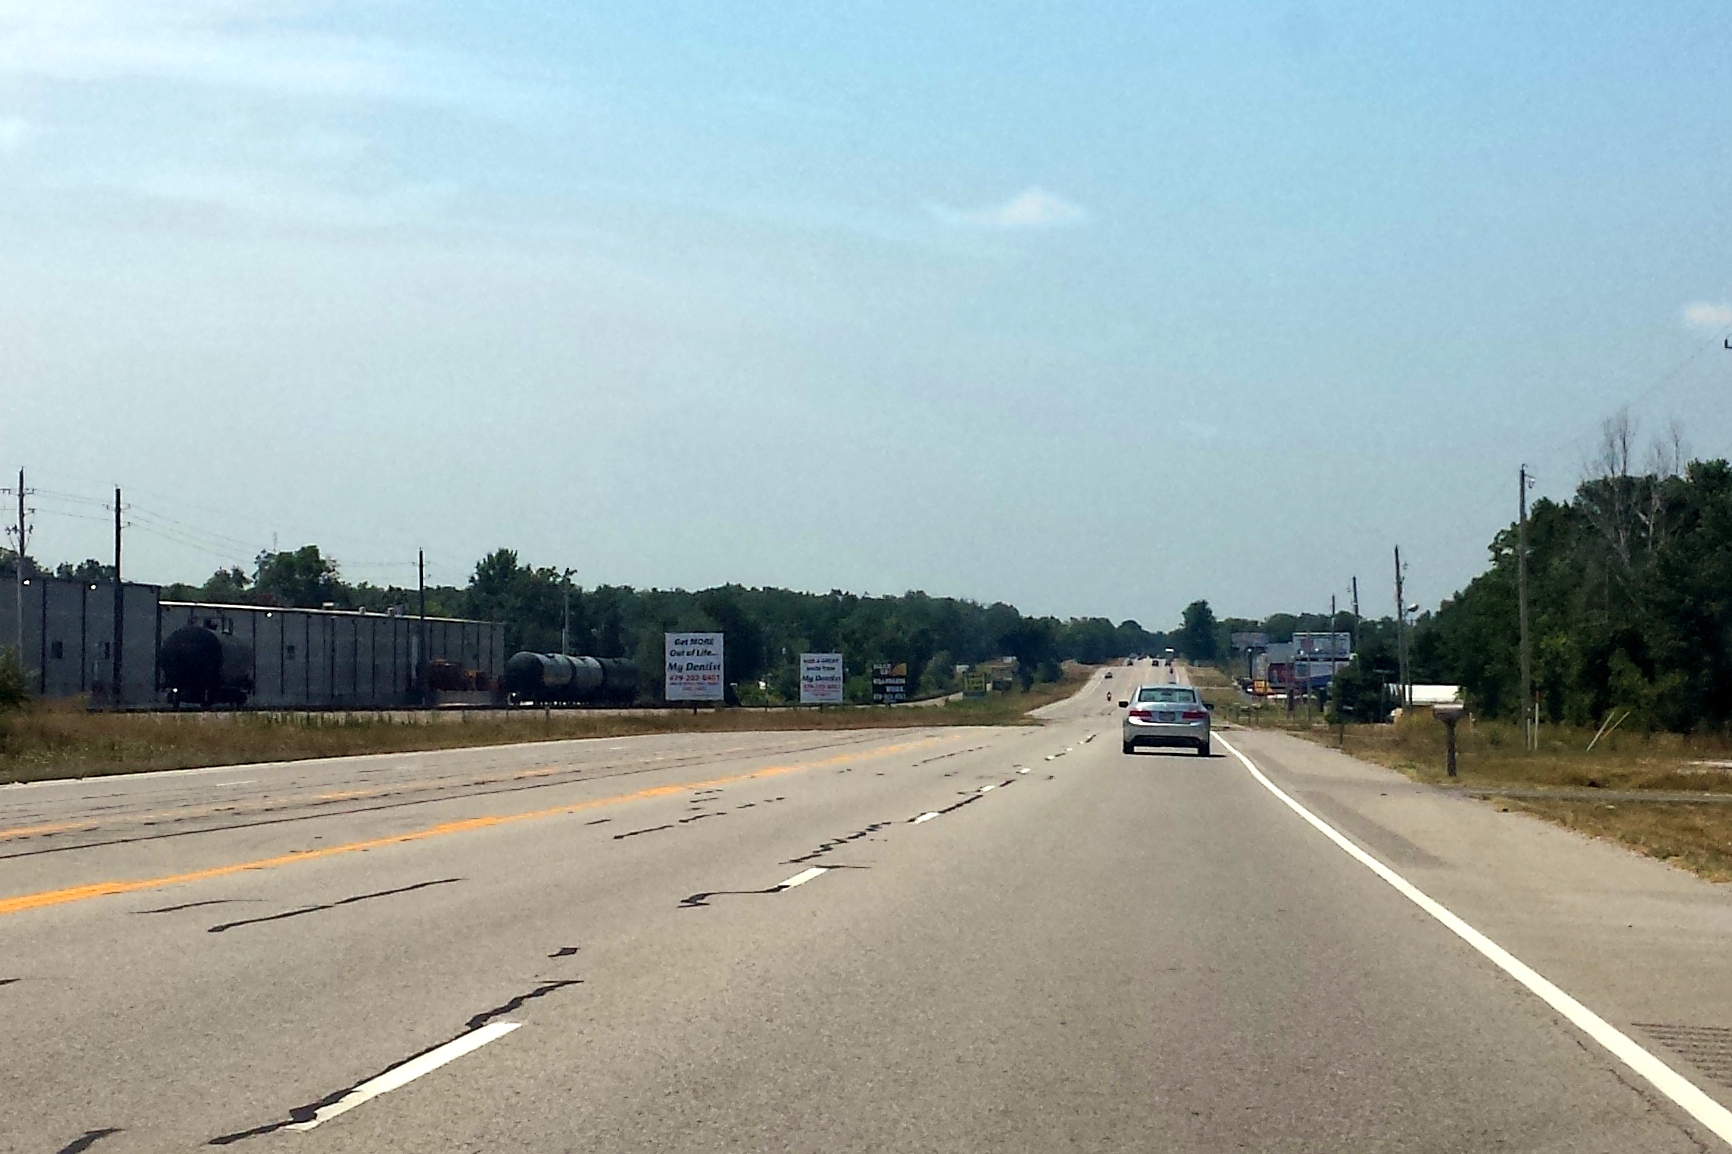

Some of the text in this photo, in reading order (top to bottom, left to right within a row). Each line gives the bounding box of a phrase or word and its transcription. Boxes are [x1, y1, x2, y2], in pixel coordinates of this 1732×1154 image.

[686, 648, 696, 656] of
[668, 662, 721, 673] My Dentist
